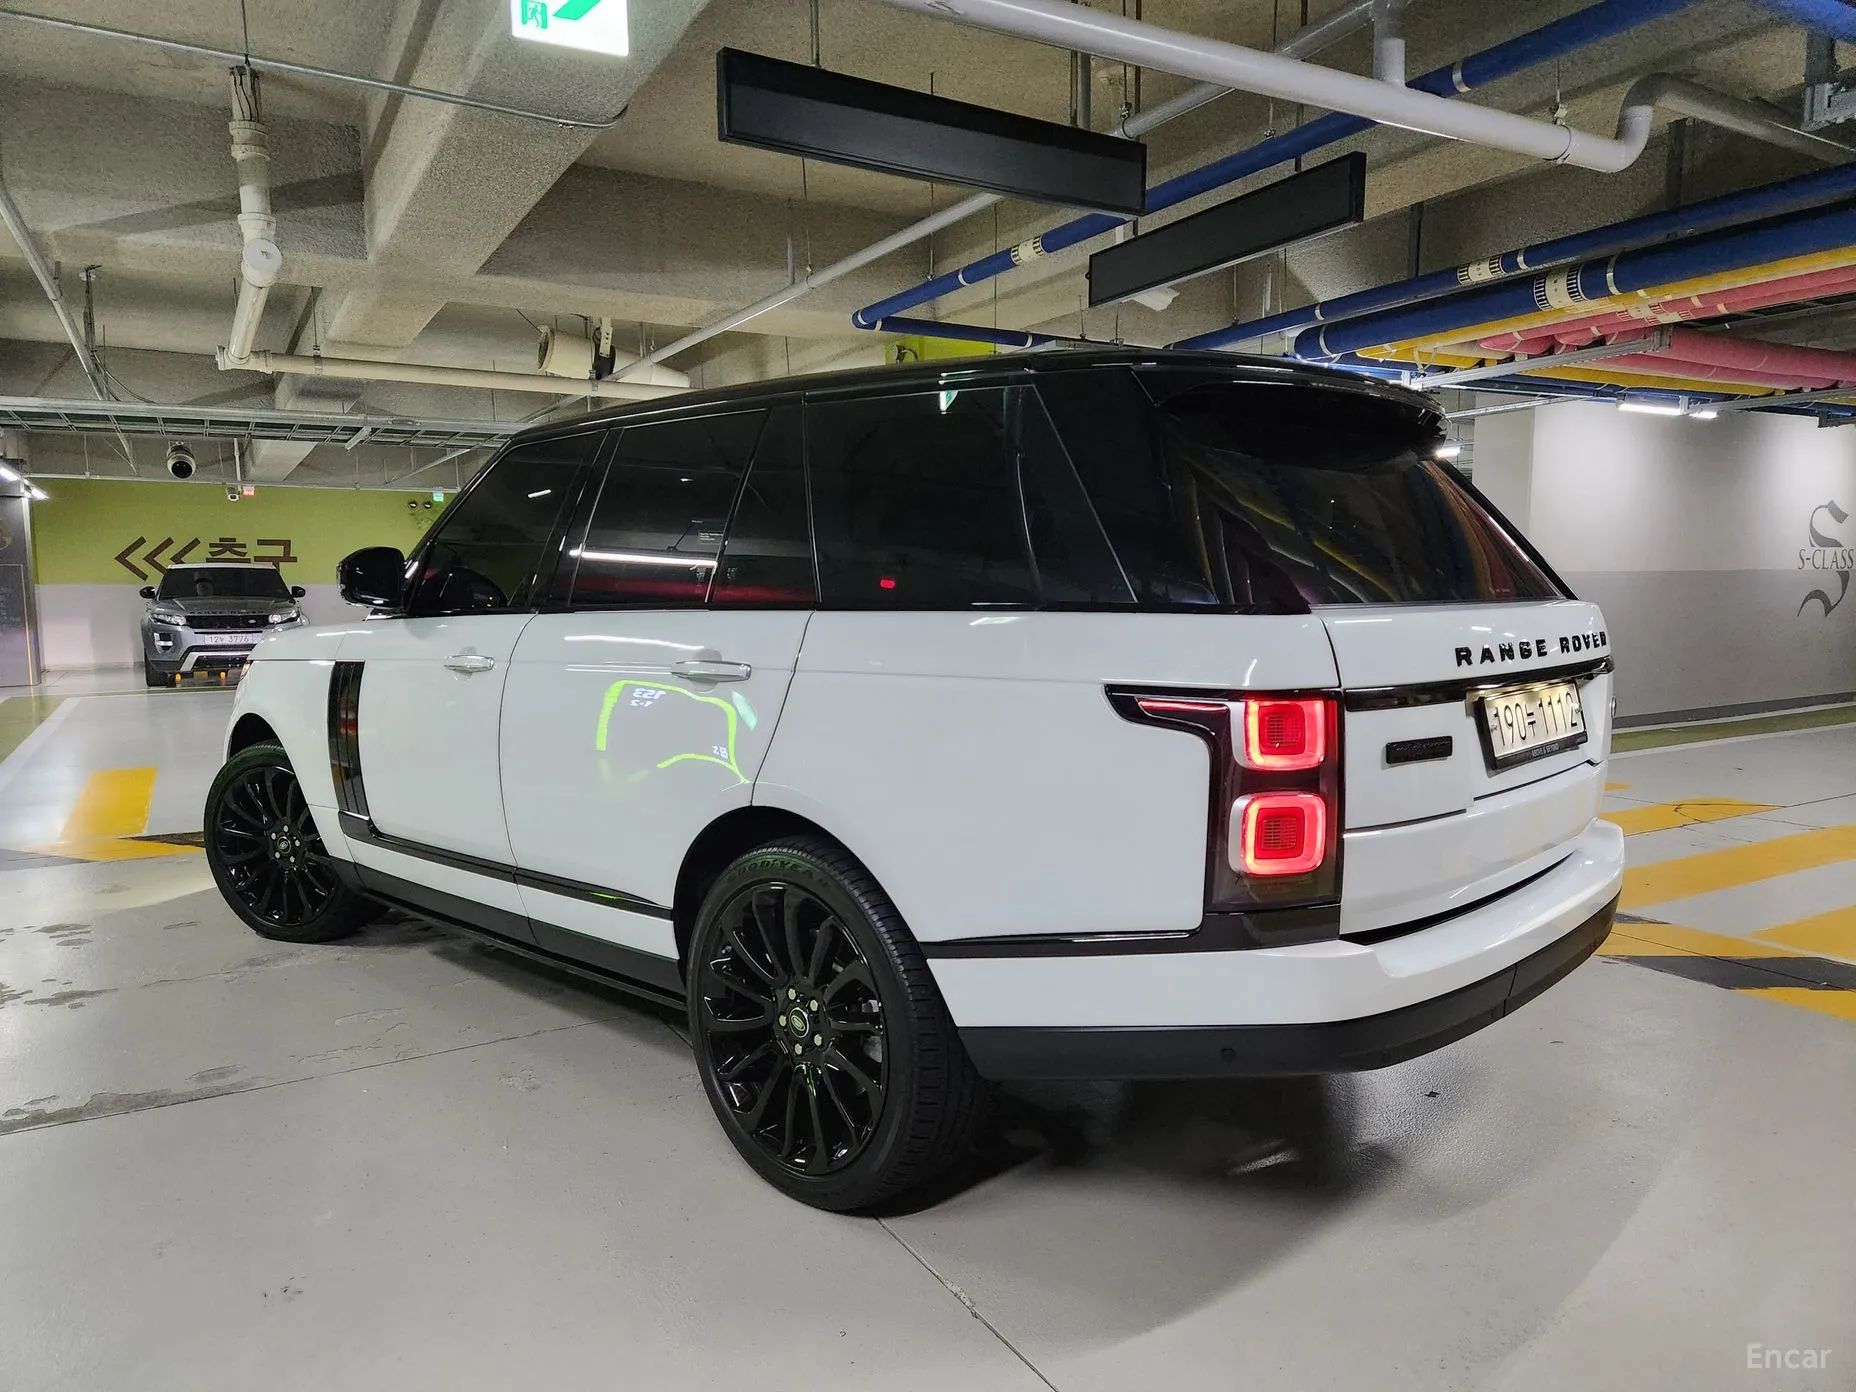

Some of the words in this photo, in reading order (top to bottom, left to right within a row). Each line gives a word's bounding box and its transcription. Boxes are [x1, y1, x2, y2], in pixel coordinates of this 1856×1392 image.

[1797, 548, 1855, 570] S-CLASS
[1454, 638, 1548, 667] RANGE
[1559, 631, 1608, 654] ROVER
